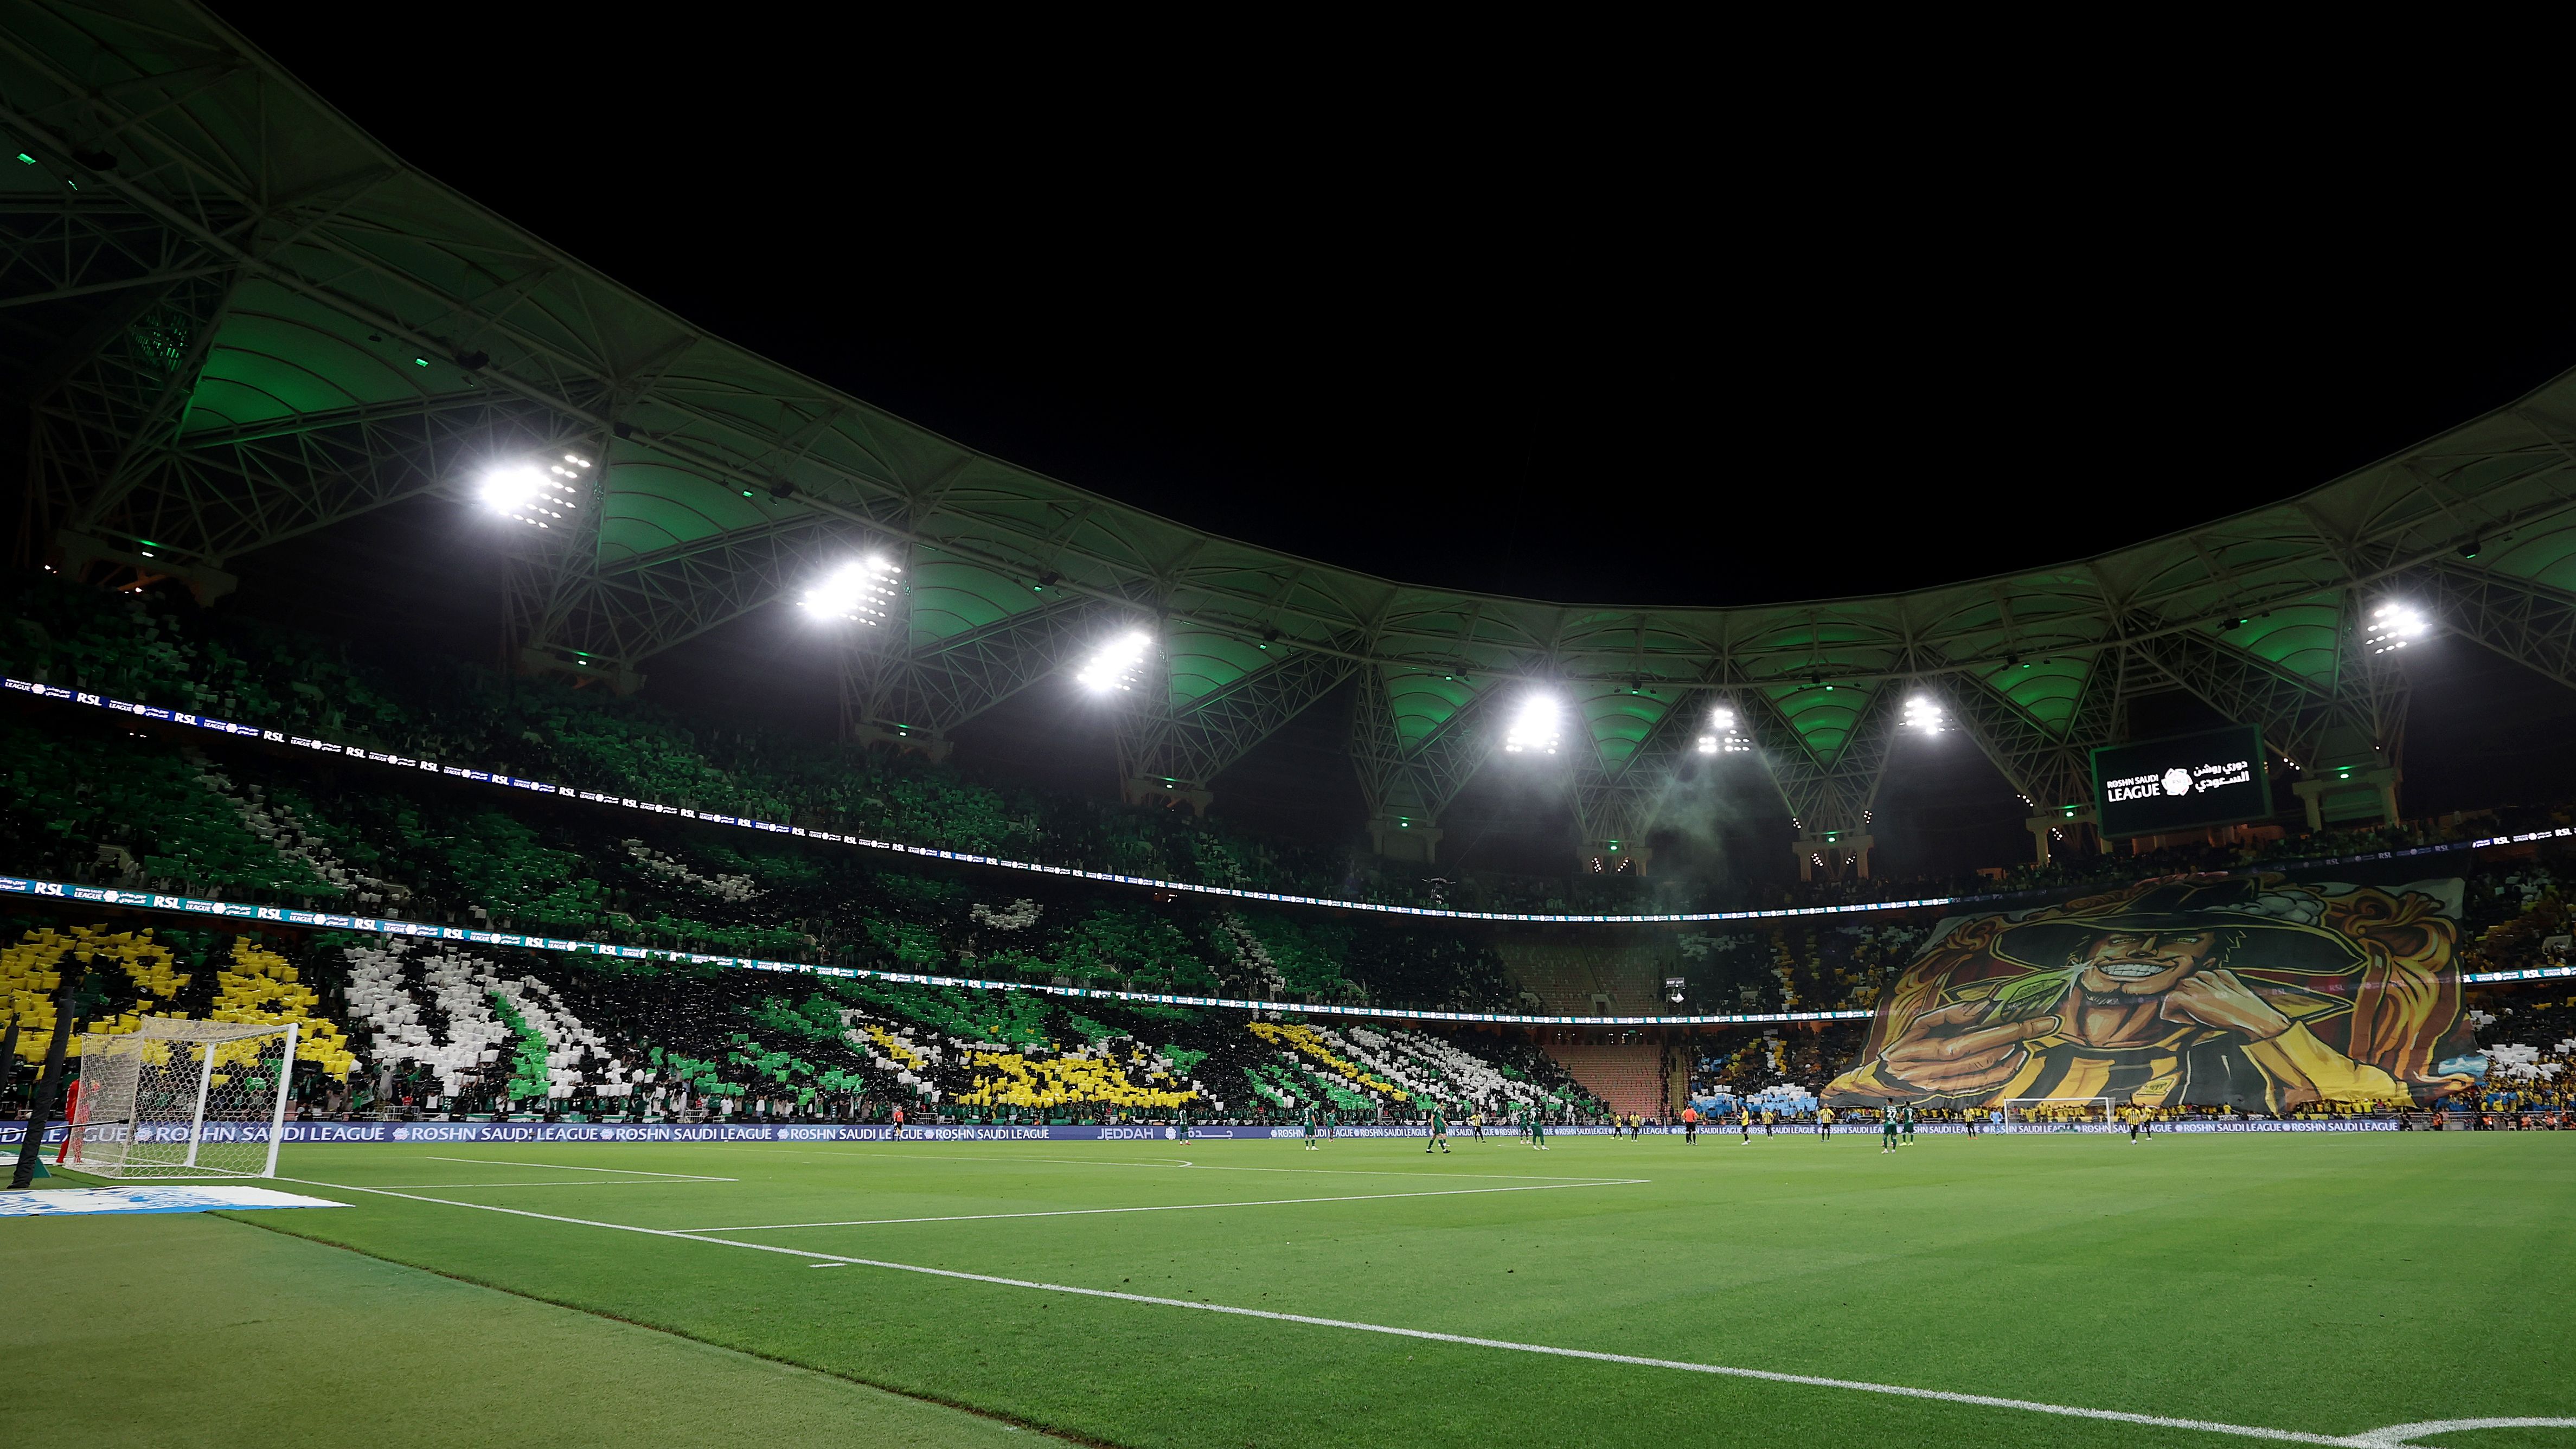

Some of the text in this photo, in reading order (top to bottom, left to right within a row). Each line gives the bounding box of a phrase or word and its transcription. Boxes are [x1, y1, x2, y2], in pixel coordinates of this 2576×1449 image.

[5, 682, 30, 691] LEAGUE
[77, 693, 101, 706] RSL
[109, 703, 133, 711] LEAGUE
[175, 713, 197, 724] RSL
[264, 731, 285, 742] RSL
[346, 747, 366, 758] RSL
[420, 761, 438, 772] RSL
[2193, 760, 2248, 777] دوري روشن
[492, 774, 509, 785] RSL
[2106, 774, 2159, 789] ROSHN SAUDI
[2195, 771, 2250, 793] السعودي
[559, 787, 575, 797] RSL
[2108, 783, 2161, 803] LEAGUE
[623, 799, 638, 807] RSL
[681, 809, 695, 818] RSL
[738, 818, 752, 827] RSL
[792, 828, 805, 836] RSL
[2555, 828, 2572, 837] RSL
[844, 836, 856, 844] RSL
[2494, 836, 2510, 845] RSL
[35, 882, 65, 896] RSL
[74, 892, 102, 900] LEAGUE
[153, 896, 181, 909] RSL
[258, 908, 282, 920] RSL
[354, 918, 377, 930] RSL
[443, 928, 464, 939] RSL
[525, 937, 544, 948] RSL
[599, 945, 617, 955] RSL
[2522, 969, 2541, 979] RSL
[1886, 1110, 1897, 1118] 27
[2183, 1123, 2282, 1132] ROSHN SAUDI LEAGUE
[2291, 1121, 2399, 1131] ROSHN SAUDI LEAGUE
[310, 1127, 385, 1141] LEAGUE
[412, 1127, 476, 1141] ROSHN
[537, 1127, 598, 1140] LEAGUE
[616, 1127, 772, 1141] ROSHN SAUDI LEAGUE
[790, 1127, 836, 1140] ROSHN
[839, 1127, 876, 1140] SAUDI
[935, 1127, 1050, 1139] ROSHN SAUDI LEAGUE
[1097, 1127, 1154, 1139] JEDDAH
[1278, 1129, 1304, 1137] ROSHN
[1360, 1128, 1427, 1137] ROSHN SAUDI LEAGUE
